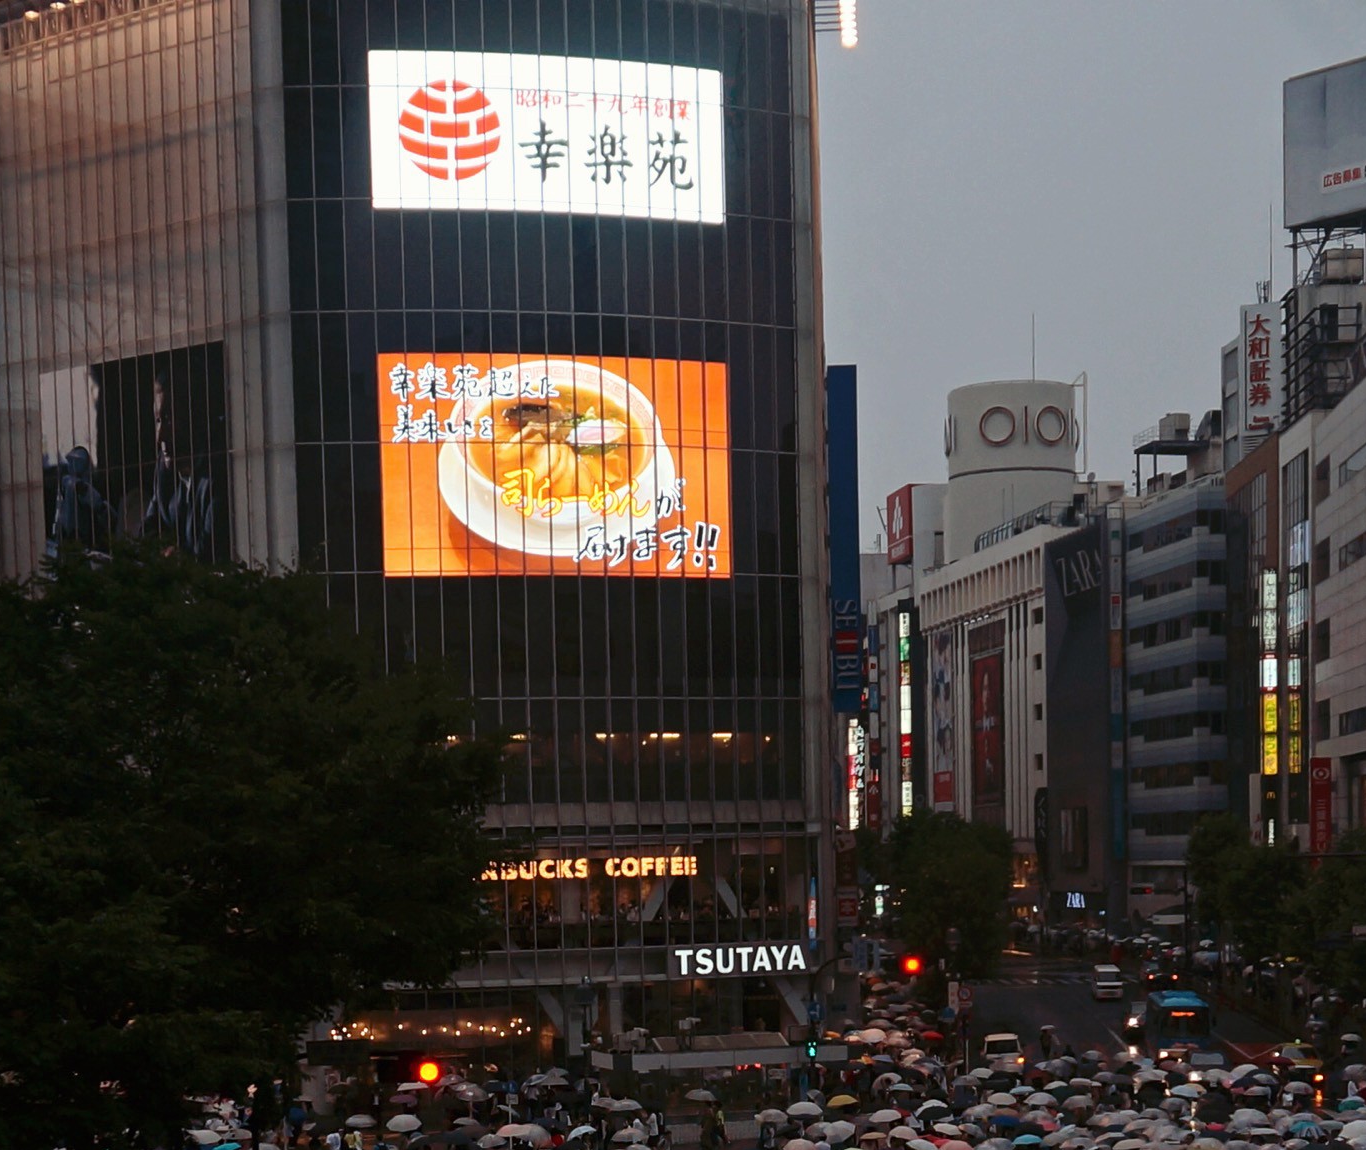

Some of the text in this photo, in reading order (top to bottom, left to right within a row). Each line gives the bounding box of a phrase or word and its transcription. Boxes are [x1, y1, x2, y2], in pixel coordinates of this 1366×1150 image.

[515, 88, 692, 121] 昭和二十九年創業
[519, 118, 694, 191] 幸楽苑
[1323, 167, 1361, 188] 広告募集
[1247, 313, 1276, 407] 大和証券
[388, 361, 561, 400] 幸楽苑超えた
[501, 467, 687, 520] 司らーめんが
[1056, 547, 1103, 599] ZARA
[834, 599, 860, 690] SEIBU
[604, 855, 699, 878] COFFEE
[1066, 891, 1087, 910] ZARA
[674, 943, 807, 977] TSUTAYA
